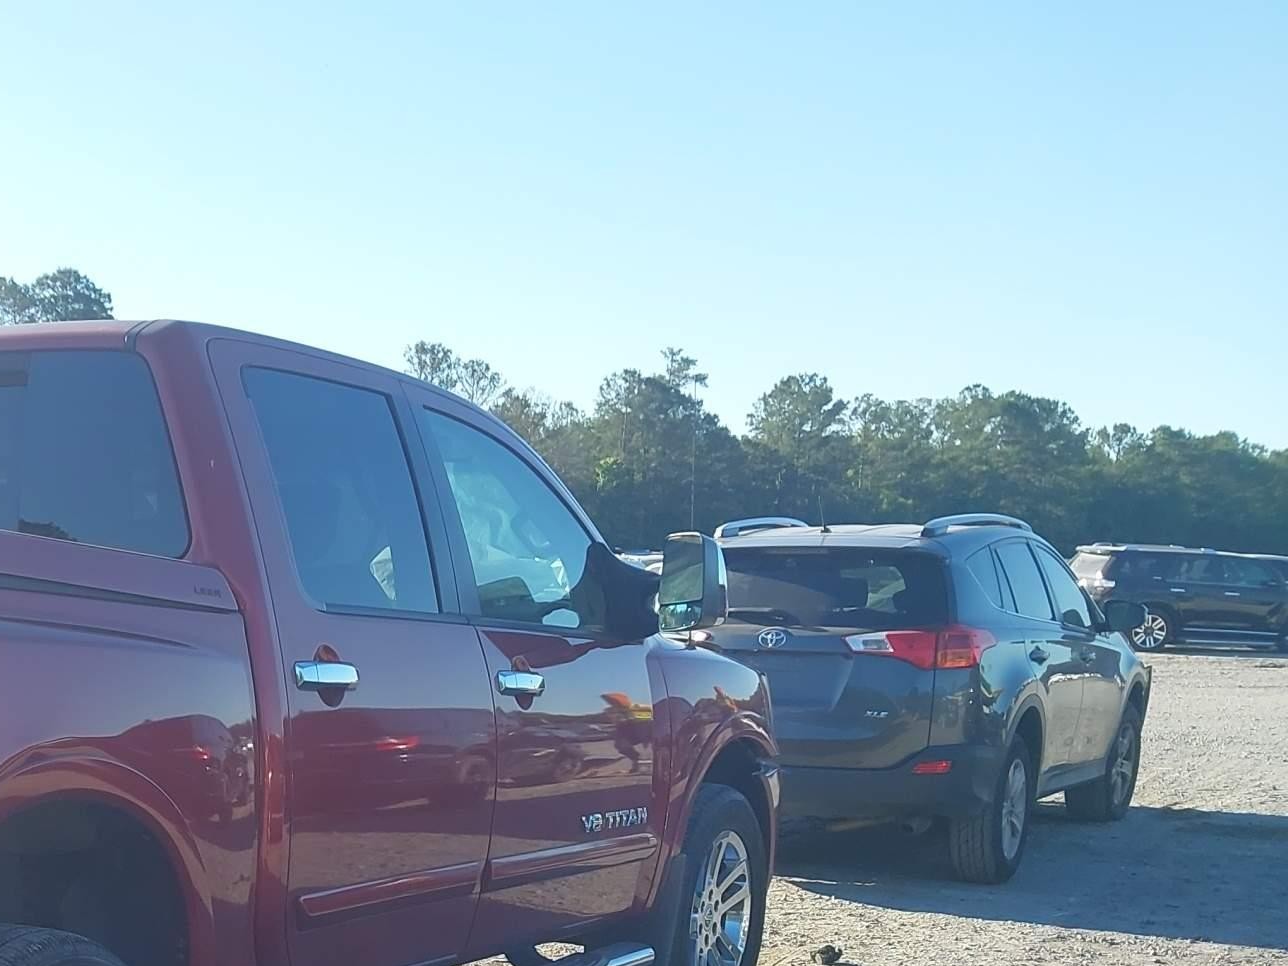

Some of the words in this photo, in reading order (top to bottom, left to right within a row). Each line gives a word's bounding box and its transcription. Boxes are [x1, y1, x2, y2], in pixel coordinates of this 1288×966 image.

[863, 710, 889, 719] XLE
[581, 813, 603, 833] V8
[605, 806, 648, 829] TITAN
